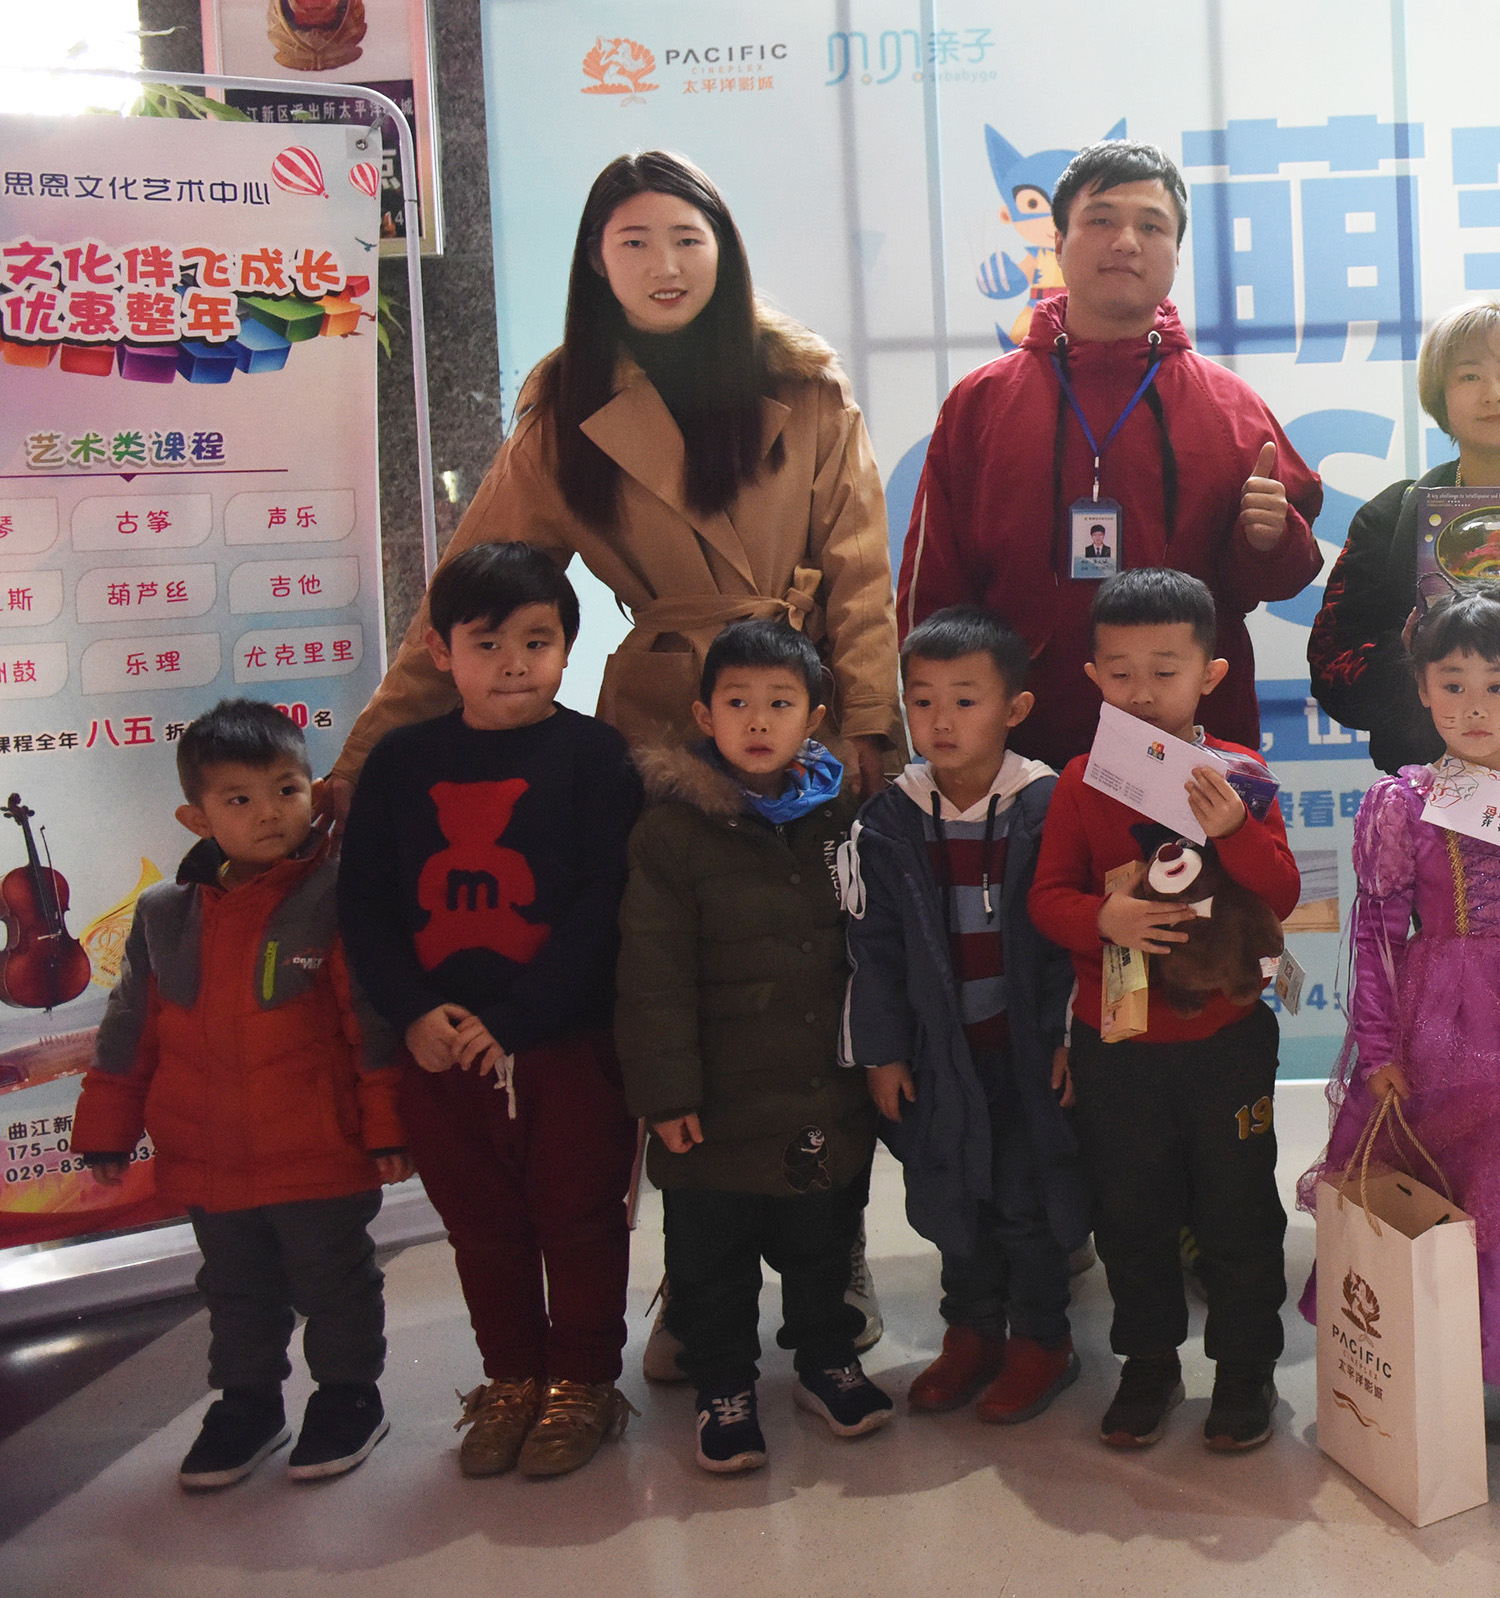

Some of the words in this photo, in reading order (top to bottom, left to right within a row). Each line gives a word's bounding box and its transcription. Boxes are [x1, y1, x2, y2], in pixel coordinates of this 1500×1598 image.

[665, 43, 789, 66] PACIFIC
[928, 28, 995, 65] 亲子
[690, 63, 765, 77] CINEPLEX
[681, 75, 776, 95] 太平洋影城
[3, 171, 271, 206] 思恩文化艺术中心
[2, 241, 342, 292] 文化伴飞成长
[5, 291, 238, 337] 优惠整年
[27, 430, 226, 465] 艺术类课程
[116, 509, 172, 535] 古筝
[267, 506, 318, 529] 声乐
[0, 587, 34, 613] 斯
[107, 580, 189, 607] 葫芦丝
[269, 575, 322, 598] 吉他
[125, 650, 181, 676] 乐理
[243, 639, 355, 668] 尤克里里
[446, 868, 499, 911] m
[8, 1115, 73, 1140] 曲江新
[1235, 1095, 1272, 1141] 19
[1332, 1323, 1393, 1379] PACIFIC
[1338, 1357, 1384, 1401] 太平洋影城
